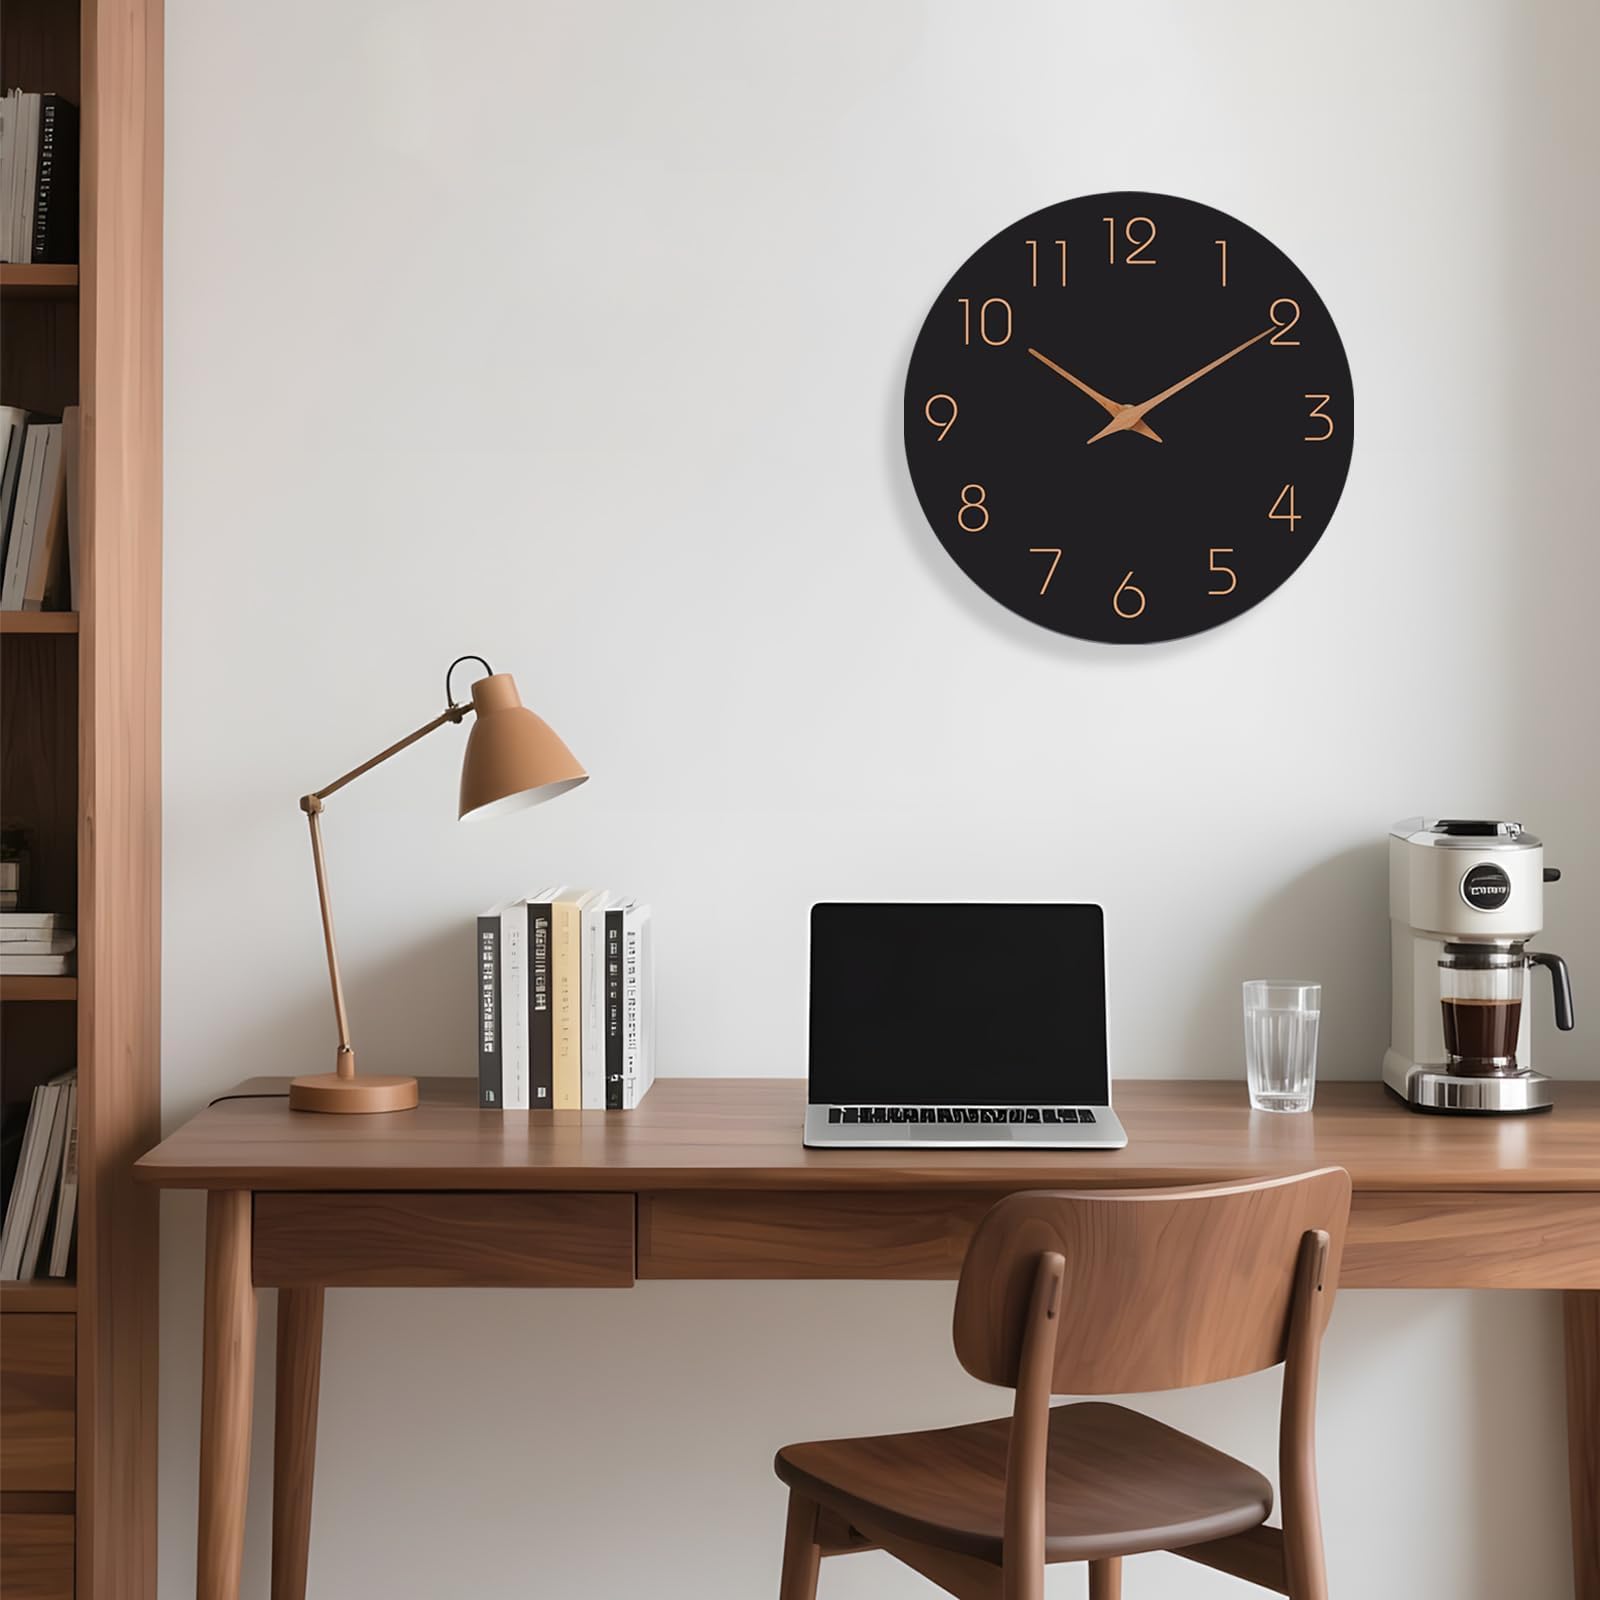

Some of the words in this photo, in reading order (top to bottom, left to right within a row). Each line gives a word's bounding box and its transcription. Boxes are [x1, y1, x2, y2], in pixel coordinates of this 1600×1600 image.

[1025, 240, 1067, 287] 11
[1103, 216, 1157, 264] 12
[1215, 240, 1228, 287] 1
[958, 298, 1013, 346] 10
[1269, 298, 1301, 346] 2
[925, 393, 959, 442] 9
[1304, 394, 1335, 441] 3
[957, 484, 990, 532] 8
[1268, 484, 1302, 532] 4
[1029, 548, 1063, 596] 7
[1113, 570, 1147, 619] 6
[1208, 548, 1238, 595] 5
